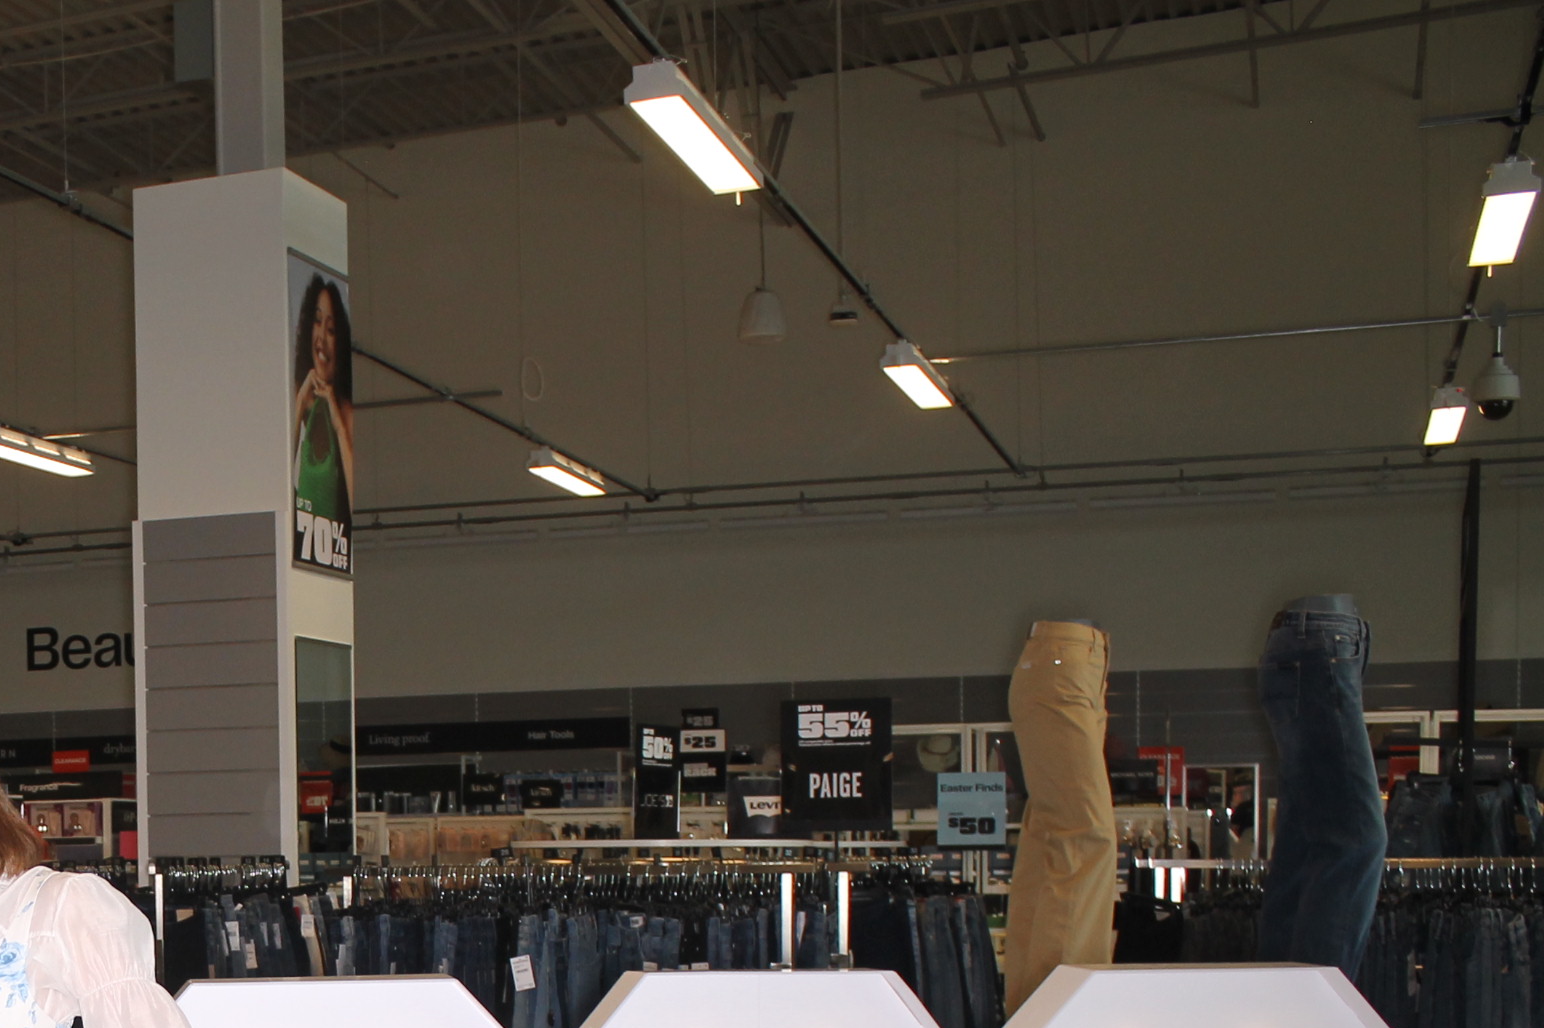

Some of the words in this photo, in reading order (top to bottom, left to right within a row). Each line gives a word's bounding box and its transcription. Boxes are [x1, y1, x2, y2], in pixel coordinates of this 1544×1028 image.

[296, 510, 348, 566] 70%
[332, 553, 348, 570] OFF
[812, 704, 824, 712] TO
[798, 711, 872, 739] 55%
[528, 731, 546, 739] Hair
[548, 730, 575, 739] Tools
[849, 728, 872, 737] OFF
[368, 734, 400, 747] Living
[684, 736, 717, 749] $25
[54, 757, 87, 765] CLEARANCE
[809, 771, 863, 798] PAIGE
[940, 783, 973, 792] Easter
[975, 783, 1004, 792] Finds
[948, 817, 996, 835] $50
